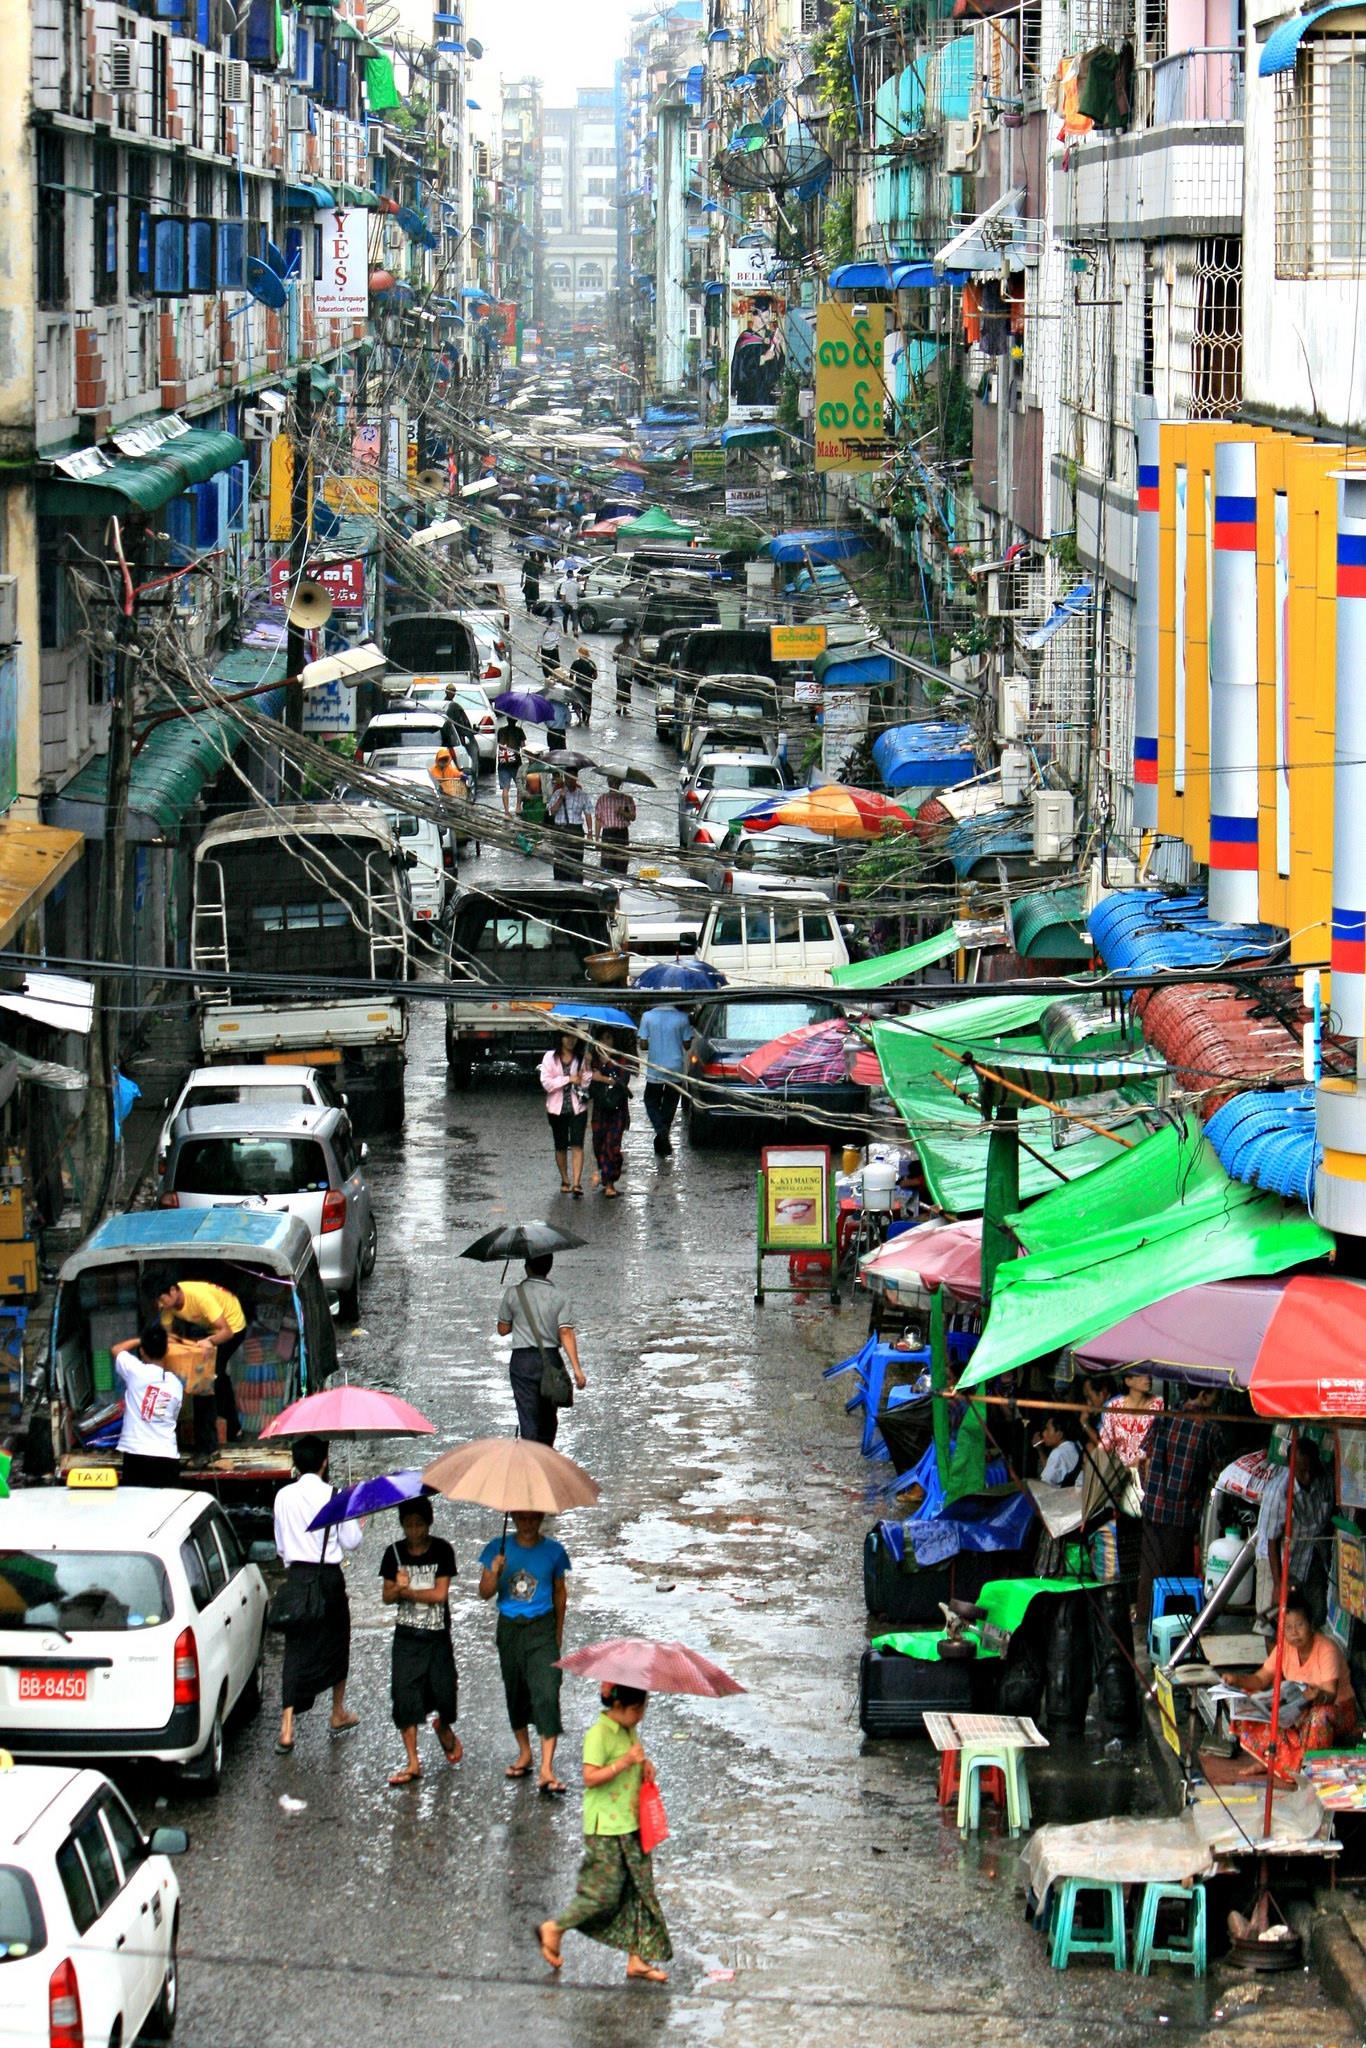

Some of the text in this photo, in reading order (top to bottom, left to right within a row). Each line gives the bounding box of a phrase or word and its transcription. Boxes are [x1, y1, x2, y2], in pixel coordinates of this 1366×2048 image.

[316, 295, 366, 303] English Language
[819, 319, 882, 368] လင်း
[818, 380, 882, 429] လင်း
[76, 1472, 110, 1482] TAXI
[20, 1677, 86, 1698] BB-8450
